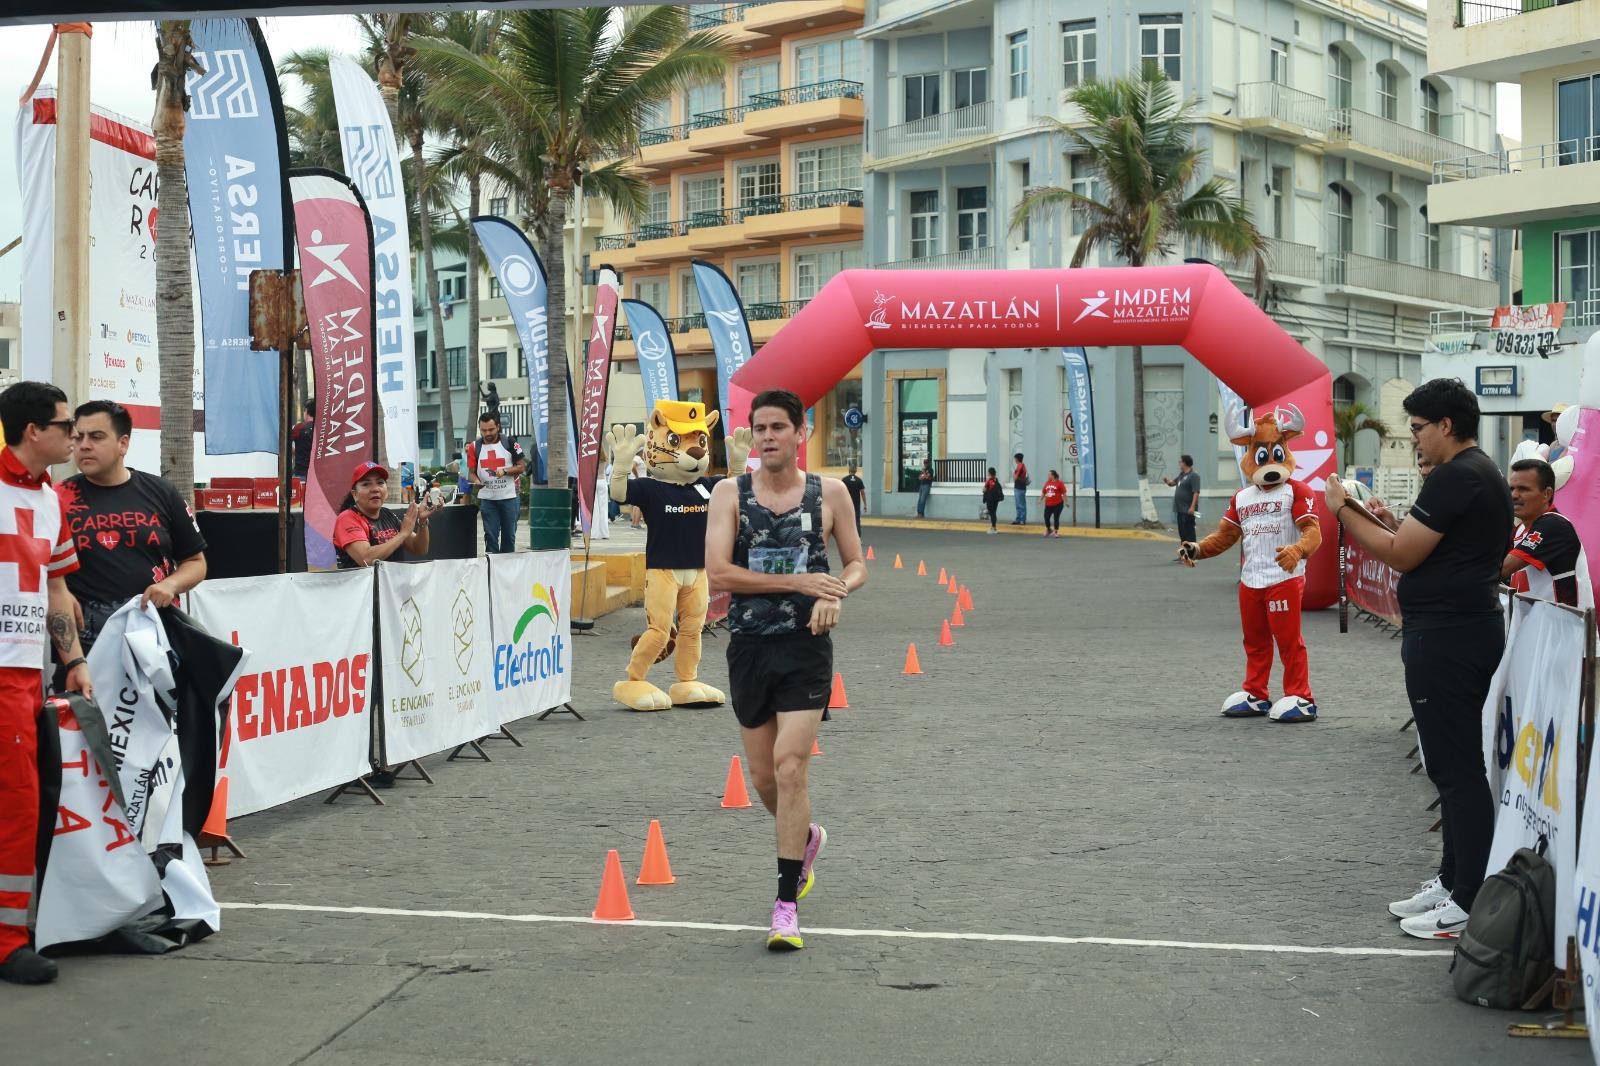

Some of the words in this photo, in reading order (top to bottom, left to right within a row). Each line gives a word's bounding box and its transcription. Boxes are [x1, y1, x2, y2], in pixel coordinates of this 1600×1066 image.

[1114, 287, 1191, 306] IMDEM
[901, 296, 1039, 319] MAZATLÁN
[1113, 303, 1190, 318] MAZATLÁN
[226, 494, 232, 508] 3
[70, 511, 161, 533] CARRERA
[1268, 599, 1289, 612] 911
[219, 645, 369, 769] ENADOS
